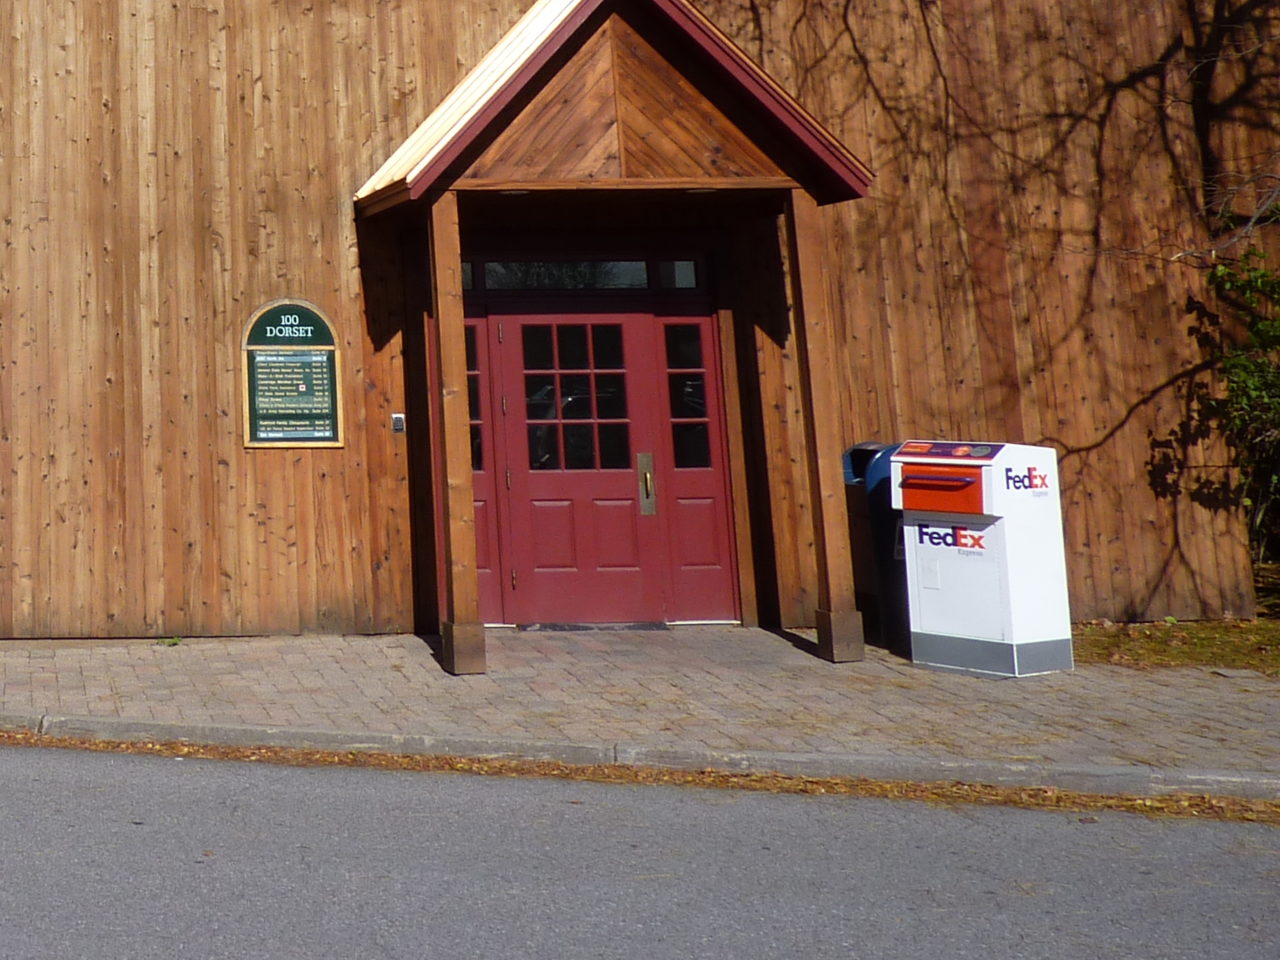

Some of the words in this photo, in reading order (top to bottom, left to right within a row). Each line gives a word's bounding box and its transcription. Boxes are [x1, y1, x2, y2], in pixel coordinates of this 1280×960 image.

[280, 315, 299, 325] 100
[265, 326, 314, 337] DORSET
[1005, 466, 1049, 490] FedEx
[917, 523, 986, 549] FedEx
